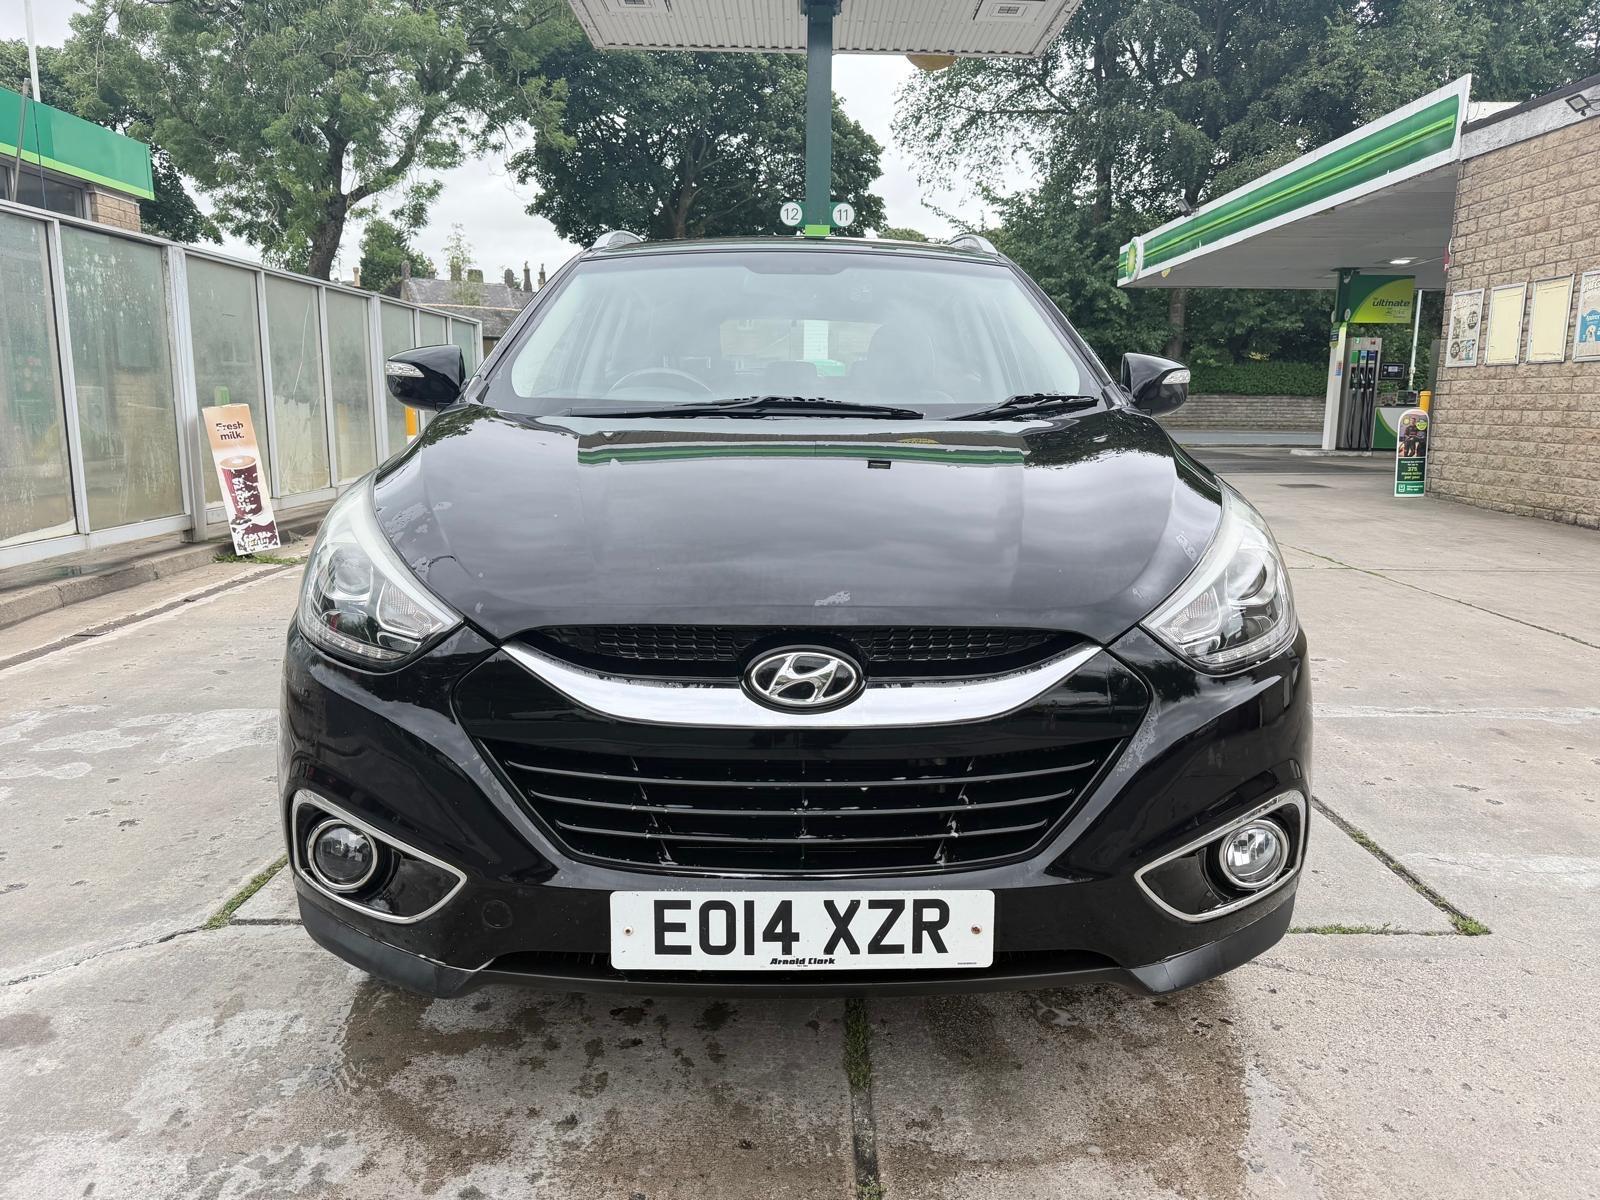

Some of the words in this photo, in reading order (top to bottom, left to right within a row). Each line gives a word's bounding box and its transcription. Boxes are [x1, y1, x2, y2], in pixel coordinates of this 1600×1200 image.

[784, 208, 799, 221] 12
[837, 209, 849, 221] 11
[220, 431, 245, 440] milk.
[653, 900, 800, 956] EO14
[823, 899, 950, 955] XZR
[769, 957, 806, 965] Arnold
[808, 957, 836, 965] Clark
